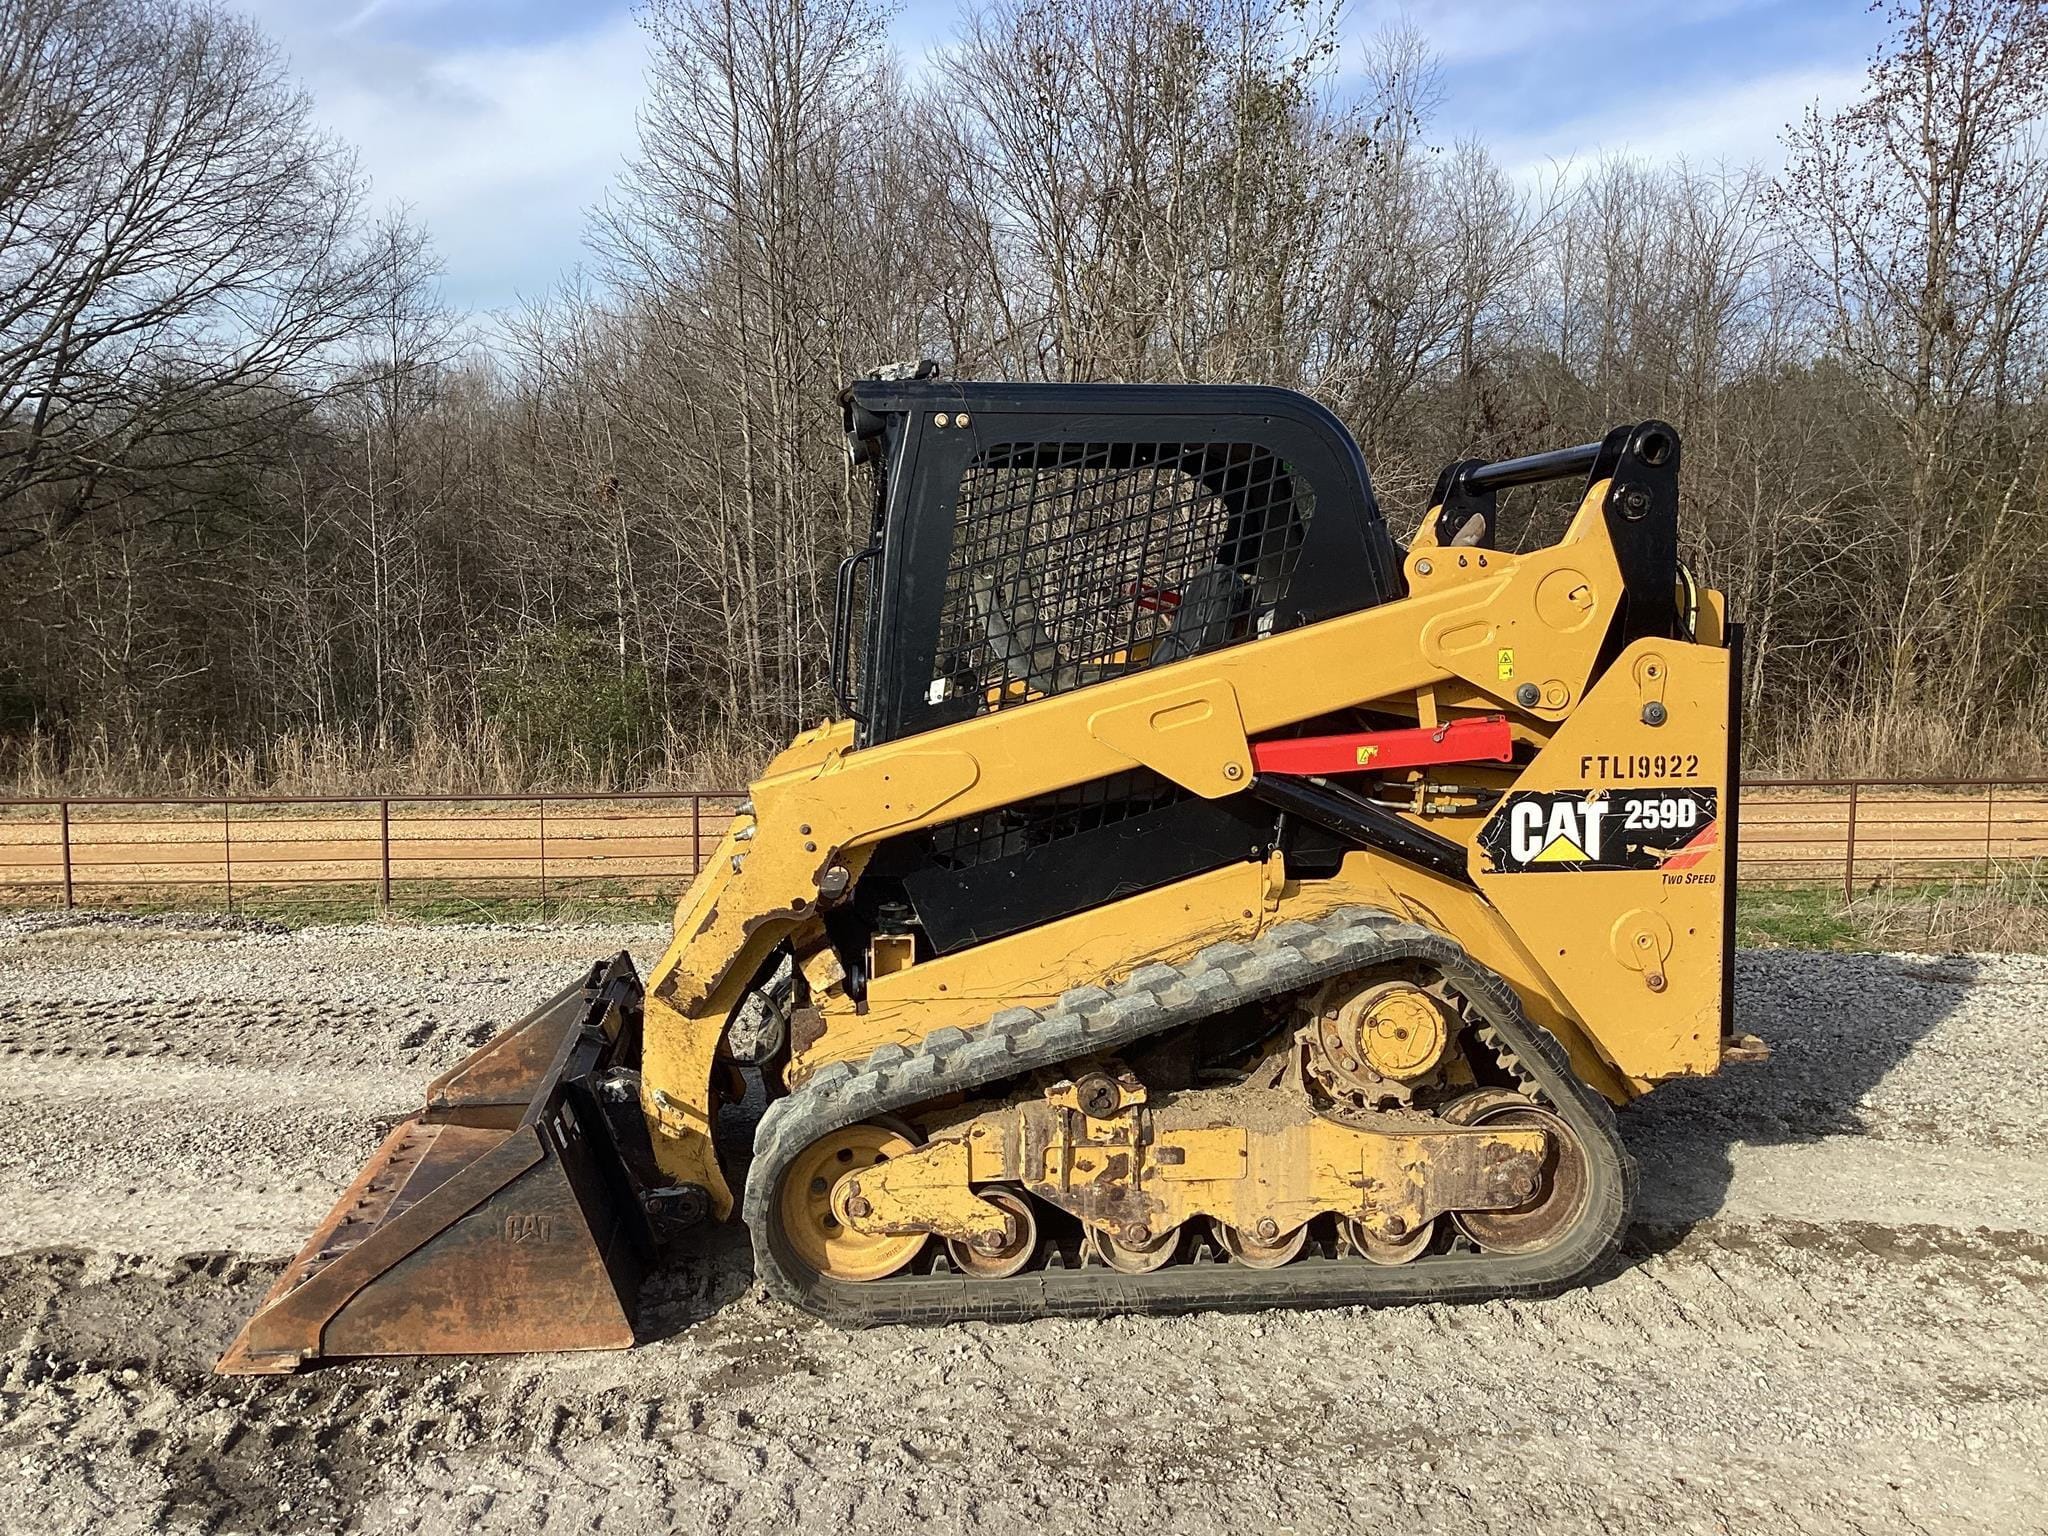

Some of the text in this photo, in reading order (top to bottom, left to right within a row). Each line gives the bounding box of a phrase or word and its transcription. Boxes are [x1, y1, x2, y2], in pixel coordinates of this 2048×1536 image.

[1510, 799, 1697, 863] CAT 259D
[505, 1214, 552, 1243] CAT
